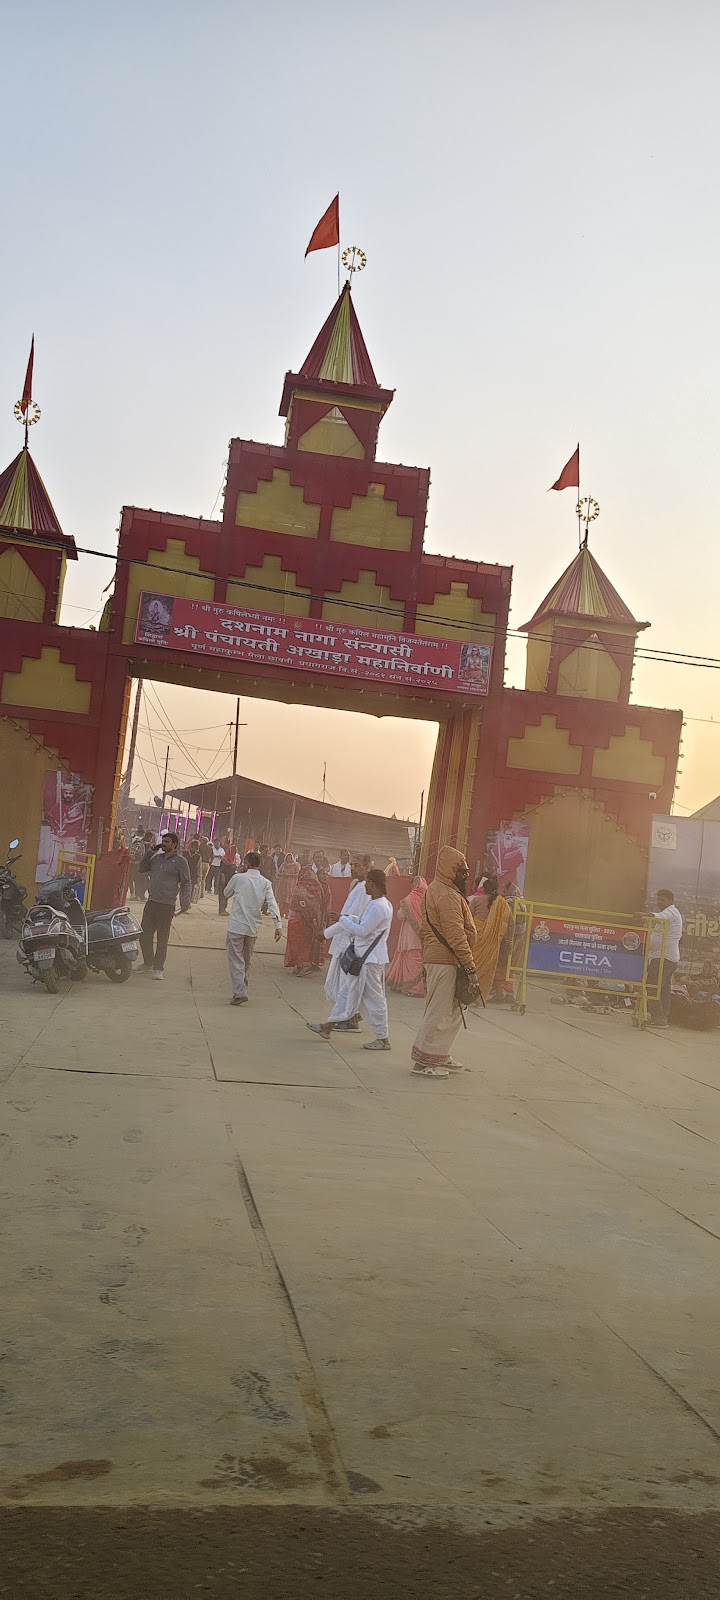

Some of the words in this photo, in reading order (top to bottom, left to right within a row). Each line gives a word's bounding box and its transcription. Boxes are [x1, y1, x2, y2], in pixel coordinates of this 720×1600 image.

[201, 604, 211, 613] श्री
[213, 607, 225, 615] गुरु
[219, 618, 290, 639] दशनाम
[294, 630, 338, 647] नागा
[342, 636, 413, 659] संन्यासी
[325, 624, 334, 633] श्री
[336, 627, 347, 636] गुरु
[349, 628, 370, 638] कपिल
[371, 632, 397, 643] महामुनि
[173, 624, 199, 640] श्री
[204, 629, 281, 653] पंचायती
[286, 644, 352, 665] अखाड़ा
[356, 654, 456, 680] महानिर्वाणी
[191, 642, 206, 652] पूर्ण
[209, 646, 245, 657] महाकुम्भ
[247, 650, 265, 660] मेला
[298, 659, 337, 671] प्रयागराज
[559, 950, 612, 968] CERA
